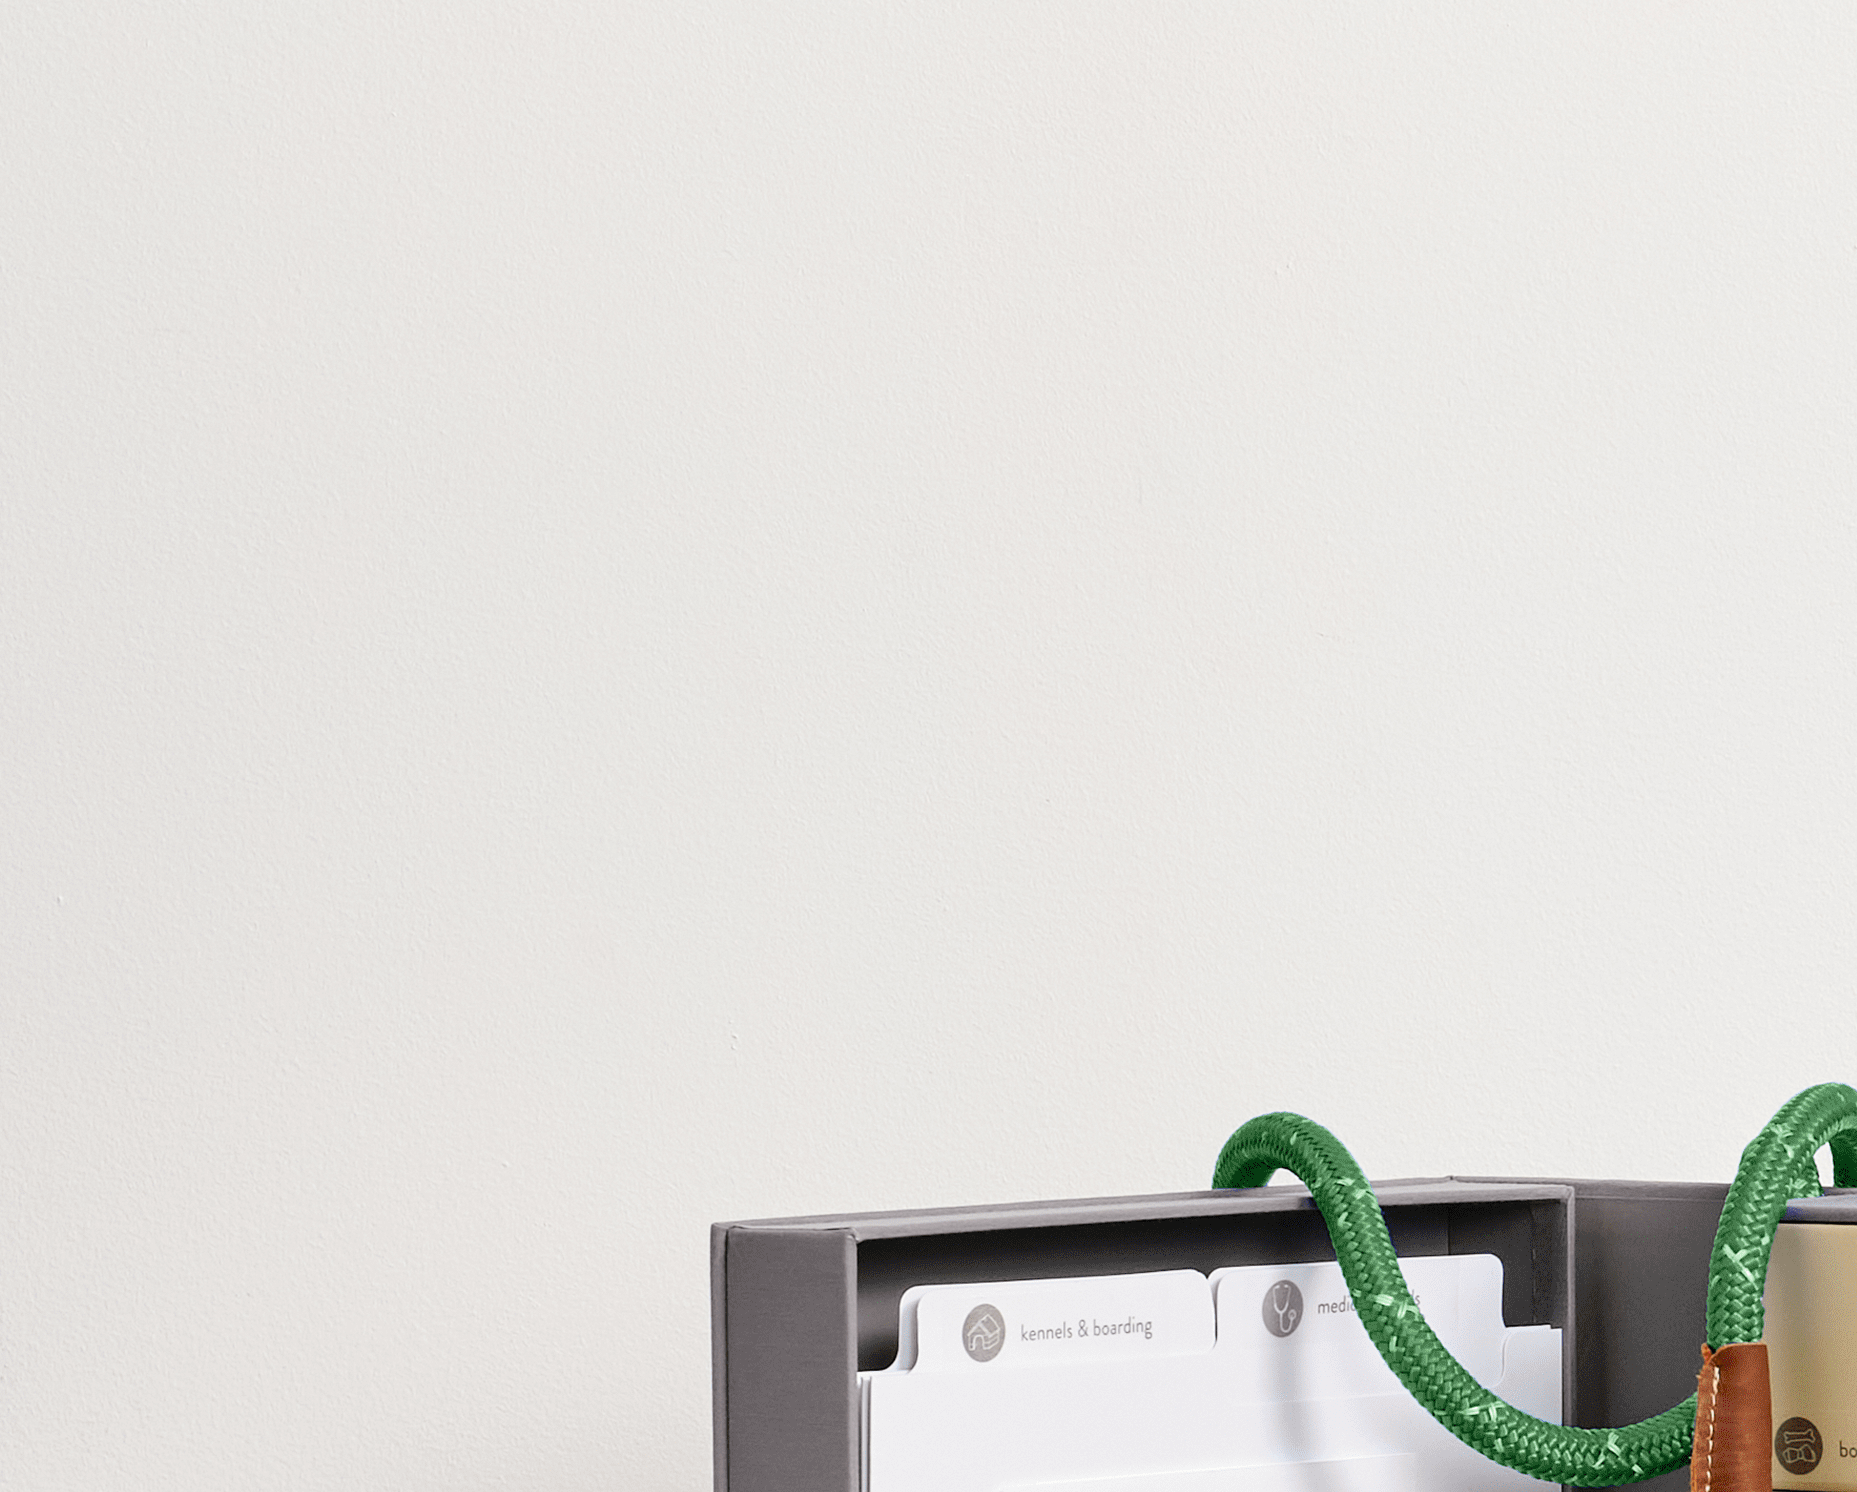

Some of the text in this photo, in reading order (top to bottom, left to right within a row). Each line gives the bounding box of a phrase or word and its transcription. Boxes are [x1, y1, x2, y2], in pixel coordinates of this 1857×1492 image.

[1021, 1316, 1153, 1341] kennels & boarding
